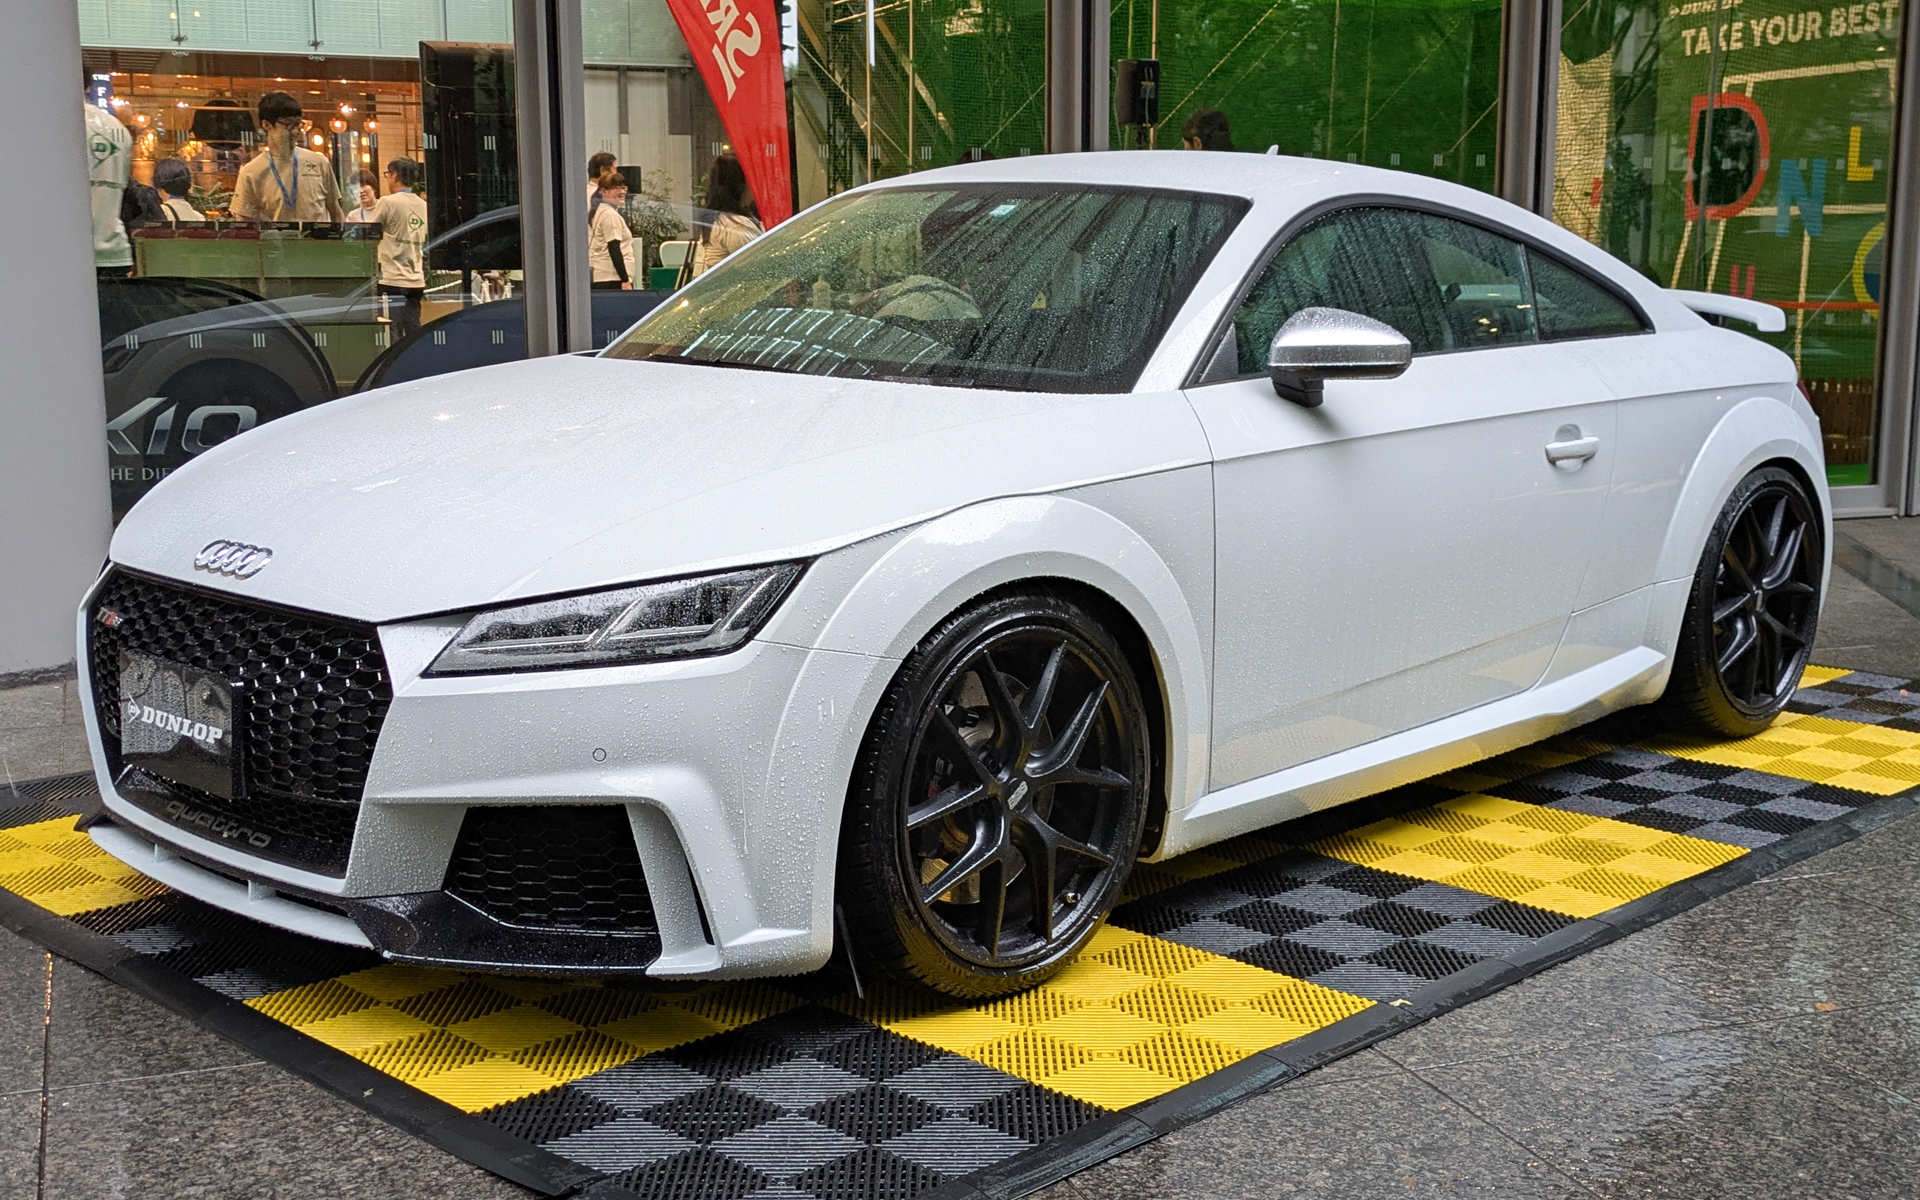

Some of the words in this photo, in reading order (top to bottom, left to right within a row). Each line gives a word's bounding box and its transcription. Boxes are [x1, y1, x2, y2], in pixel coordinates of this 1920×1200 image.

[1681, 21, 1745, 57] TAKE
[1750, 11, 1823, 48] YOUR
[1828, 0, 1900, 38] BEST
[1685, 92, 1770, 222] D
[1846, 125, 1875, 182] L
[1775, 158, 1828, 238] N
[141, 705, 224, 745] DUNLOP
[165, 799, 273, 849] quattro
[1006, 780, 1029, 811] BBS
